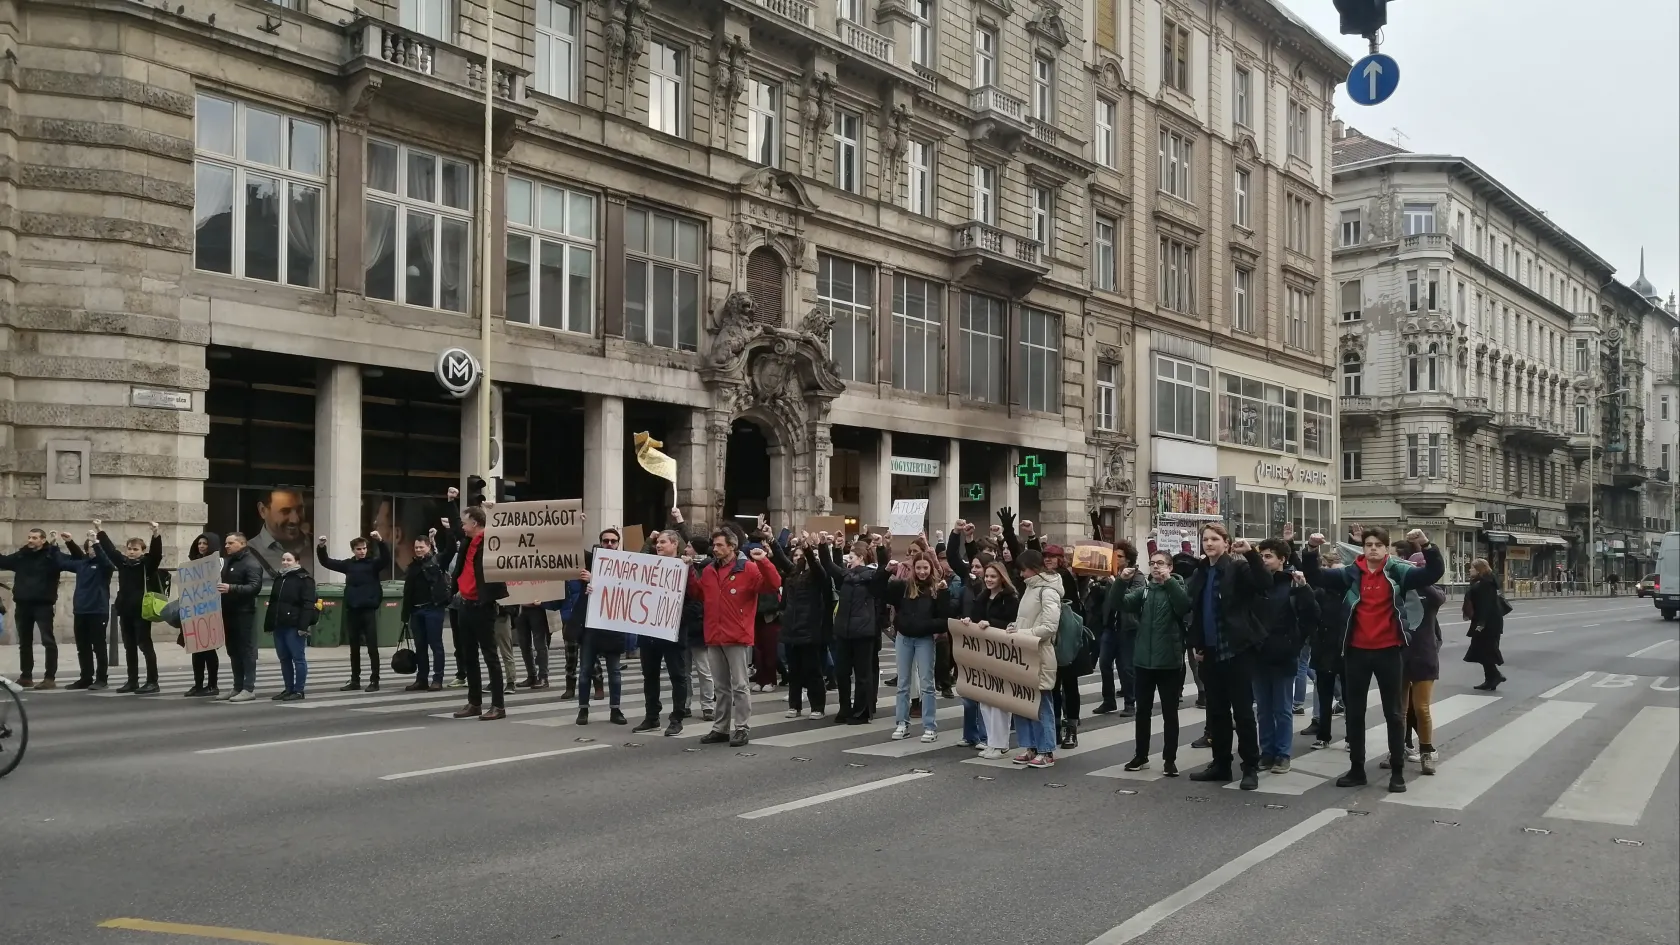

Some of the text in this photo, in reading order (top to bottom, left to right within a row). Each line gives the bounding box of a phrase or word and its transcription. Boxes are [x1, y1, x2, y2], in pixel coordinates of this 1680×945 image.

[891, 459, 931, 474] YÓGYSZERTÁR
[492, 505, 577, 527] SZABADSÁGOT
[518, 533, 535, 547] AZ
[496, 549, 579, 569] OKTATÁSBAN!
[598, 554, 682, 592] TANÁR NÉLKÜL
[962, 634, 1029, 671] AKI DUDÁL,
[962, 665, 1035, 703] VELÜNK VAN!
